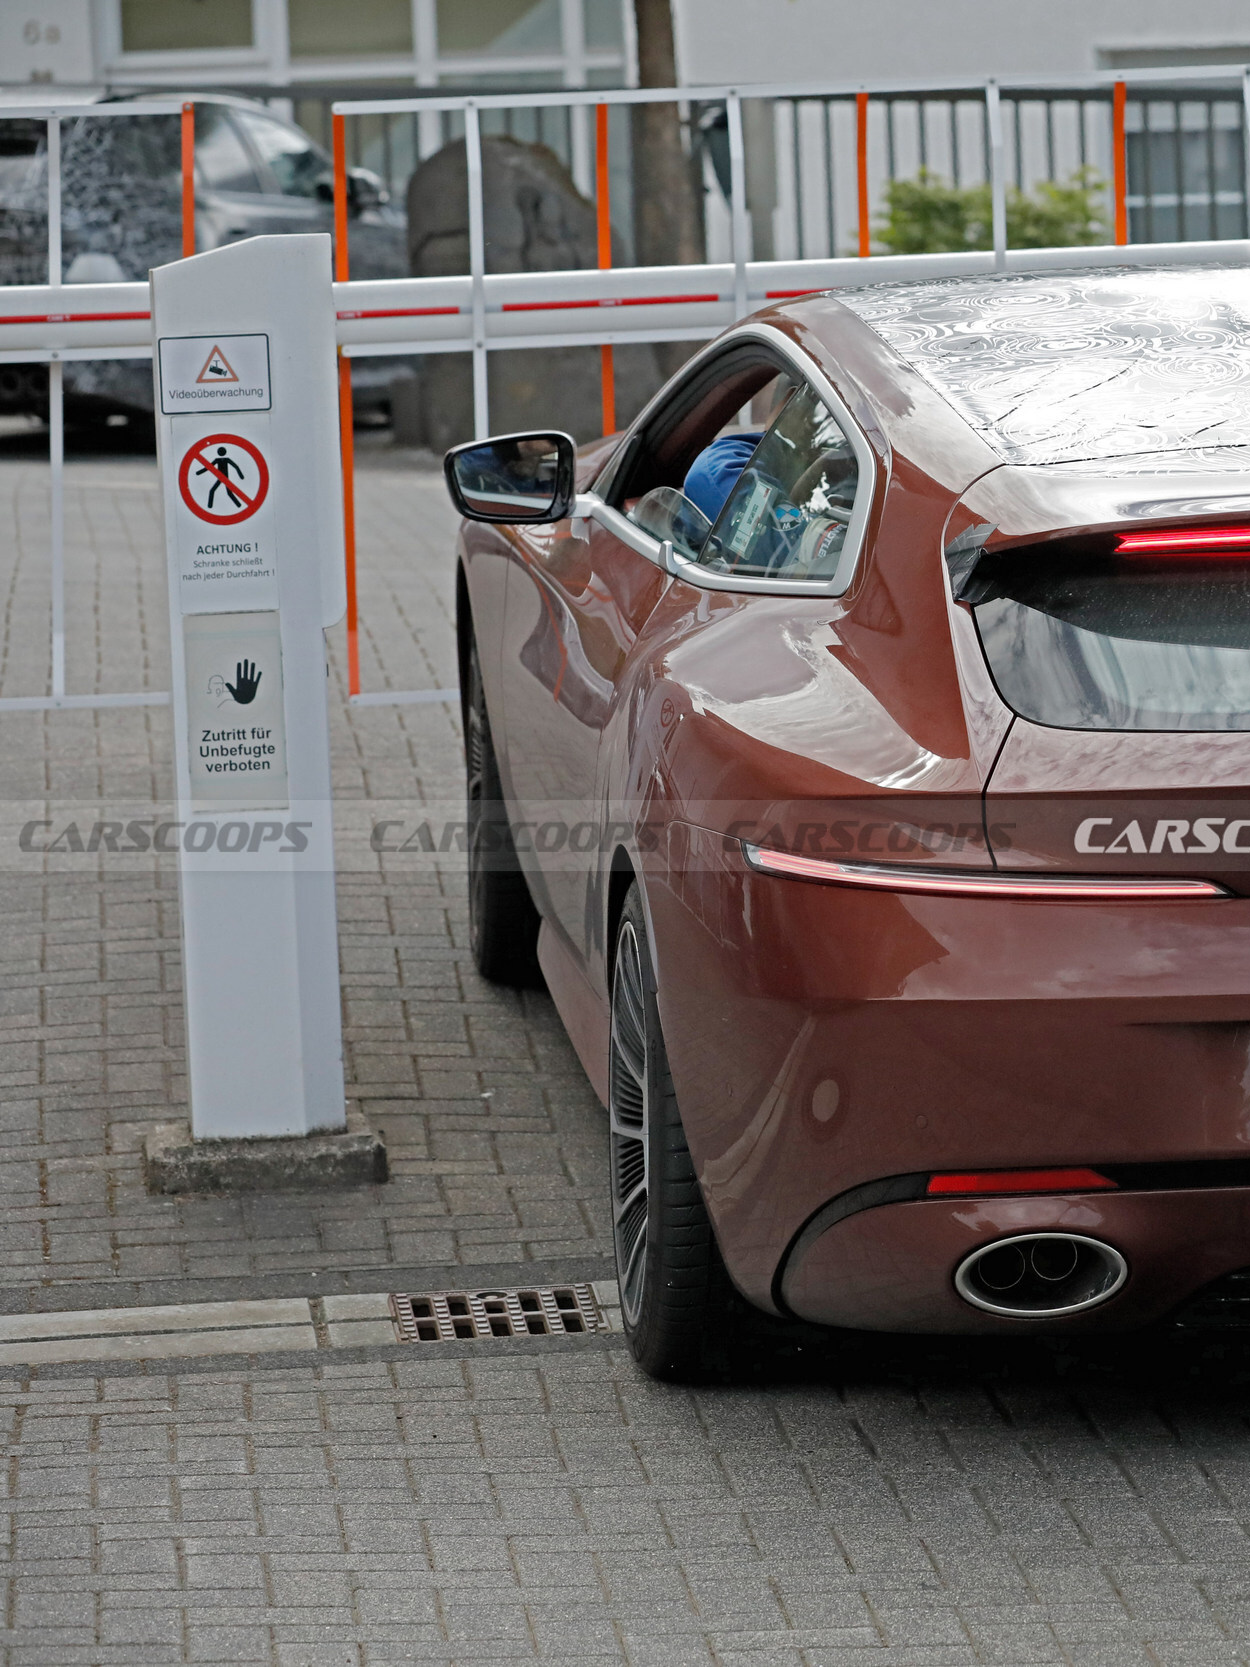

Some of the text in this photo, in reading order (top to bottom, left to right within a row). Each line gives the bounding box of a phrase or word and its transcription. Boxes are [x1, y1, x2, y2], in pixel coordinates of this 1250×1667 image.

[169, 387, 264, 400] Videoüberwachung
[196, 543, 251, 555] ACHTUNG
[193, 557, 263, 568] Schranke schließt
[182, 572, 202, 581] nach
[203, 570, 225, 581] jeder
[226, 569, 270, 579] Durchfahrt
[201, 727, 272, 742] Zutritt für
[199, 743, 276, 758] Unbefugte
[205, 760, 271, 773] verboten
